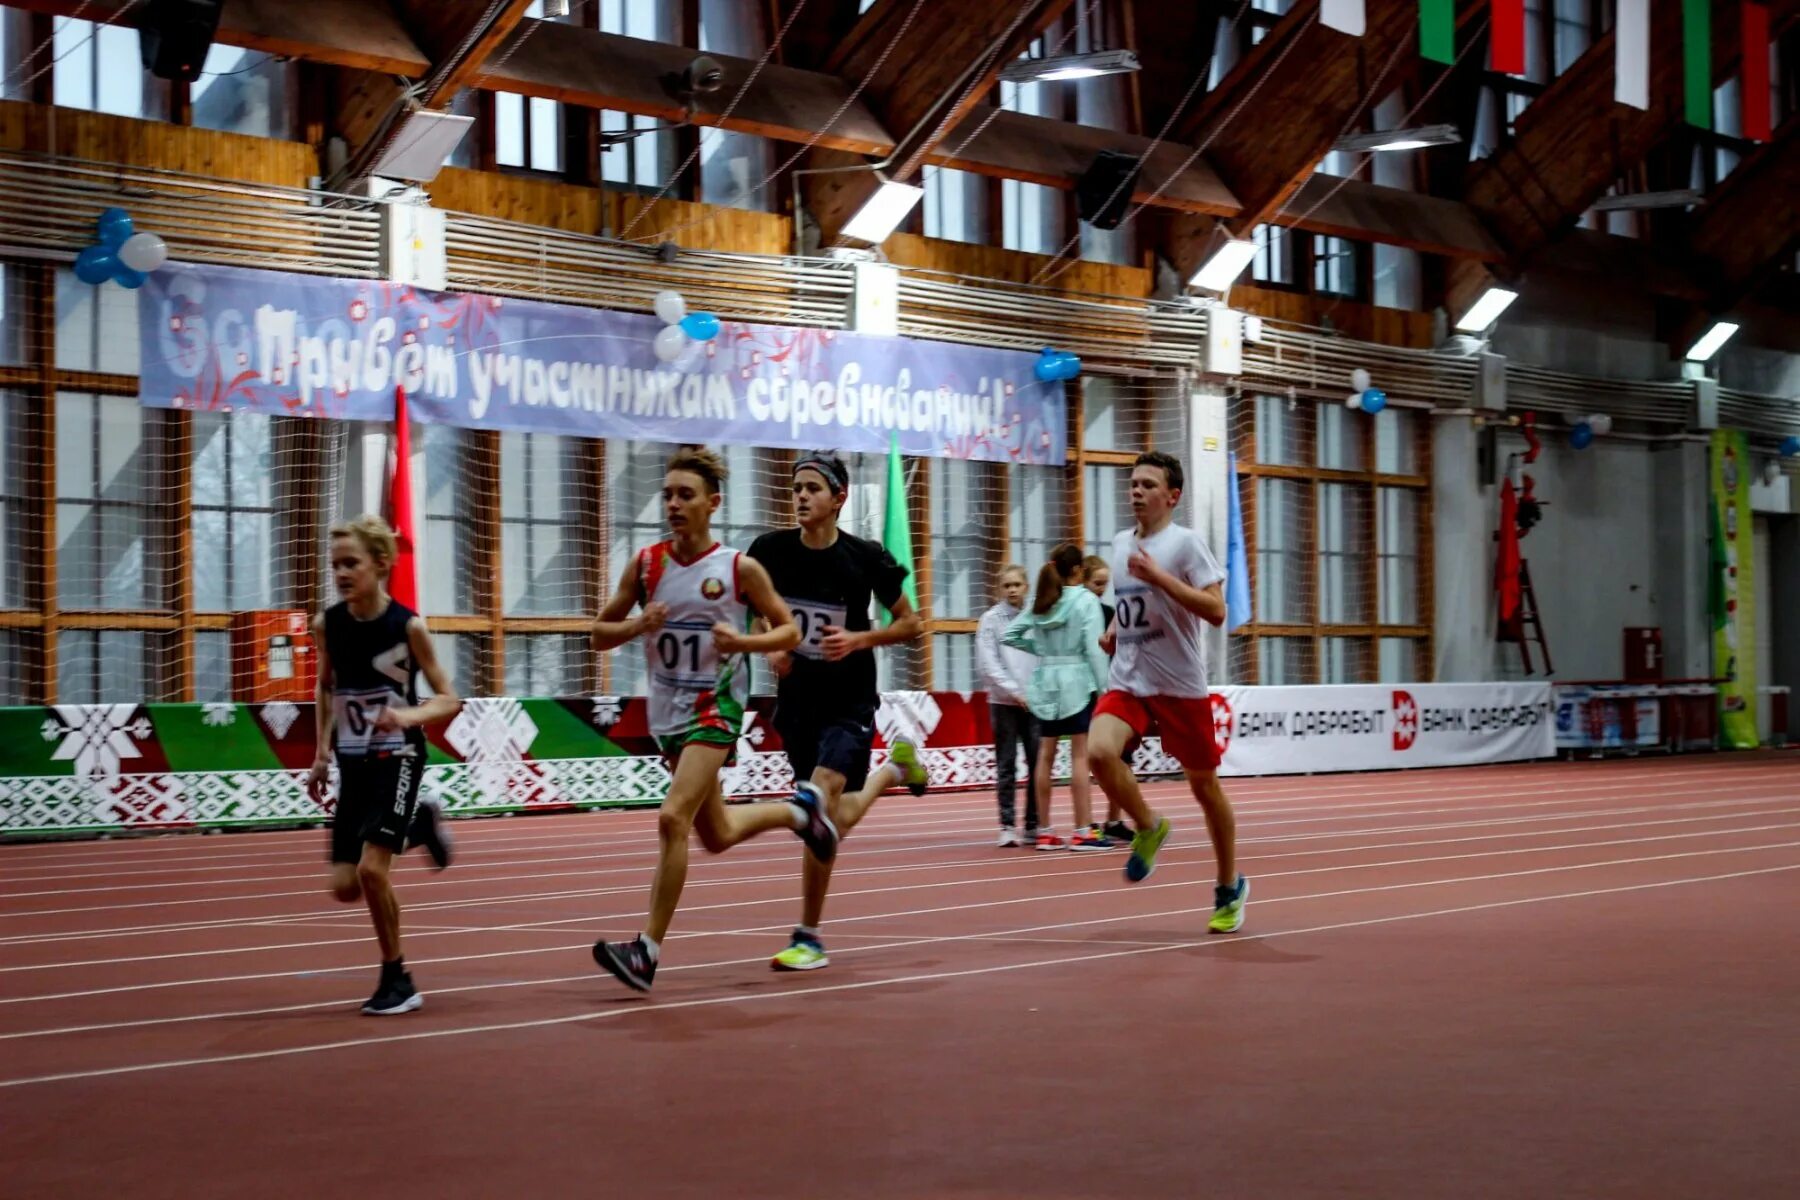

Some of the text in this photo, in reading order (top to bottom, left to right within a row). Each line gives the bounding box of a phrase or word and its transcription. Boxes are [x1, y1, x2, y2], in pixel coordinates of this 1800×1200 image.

[255, 304, 458, 405] Привет
[468, 351, 736, 420] участникам
[746, 362, 1004, 439] соревнований!
[1117, 595, 1150, 629] 02
[657, 632, 700, 672] 01
[1238, 709, 1386, 741] БАНК ДАБРАБЫТ
[1422, 707, 1467, 733] БАНК
